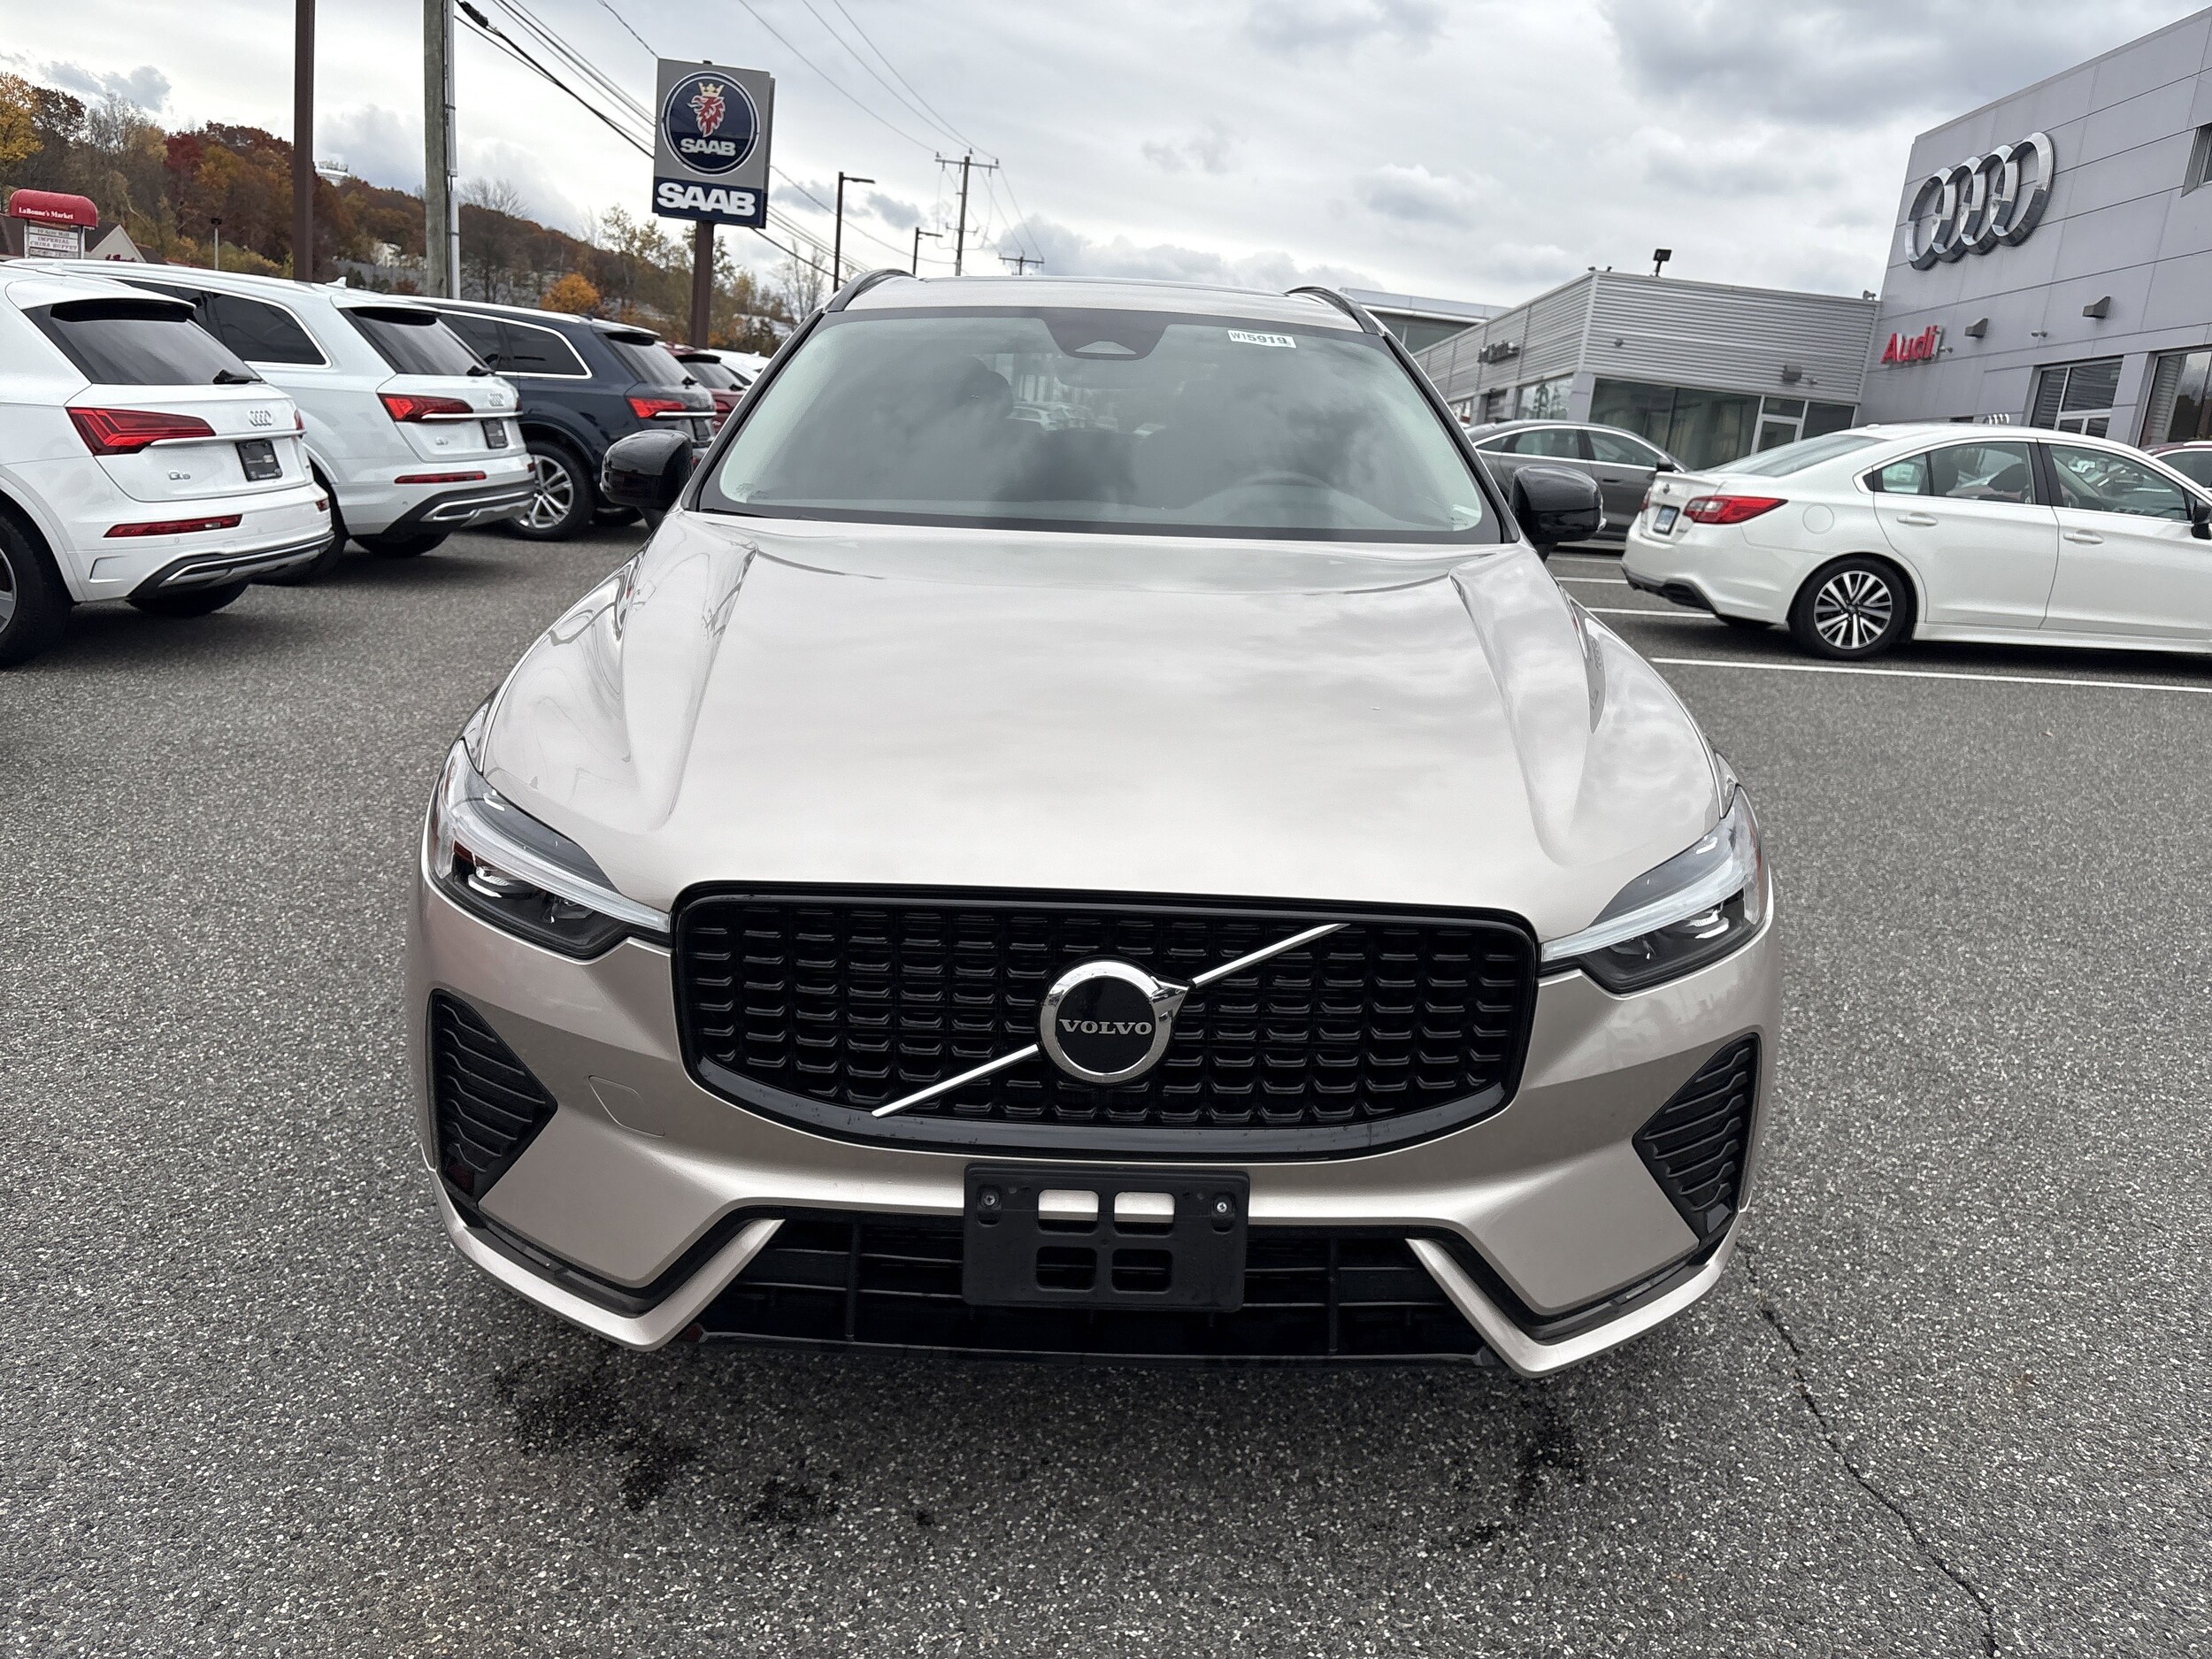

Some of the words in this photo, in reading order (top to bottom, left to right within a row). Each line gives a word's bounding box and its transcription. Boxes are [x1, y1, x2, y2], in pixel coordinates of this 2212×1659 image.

[680, 137, 737, 157] SAAB
[656, 181, 757, 218] SAAB
[19, 206, 50, 218] LaBonne's
[50, 211, 74, 220] Market
[1230, 332, 1287, 344] W15919
[1879, 324, 1940, 365] Audi
[1058, 1018, 1153, 1035] VOLVO
